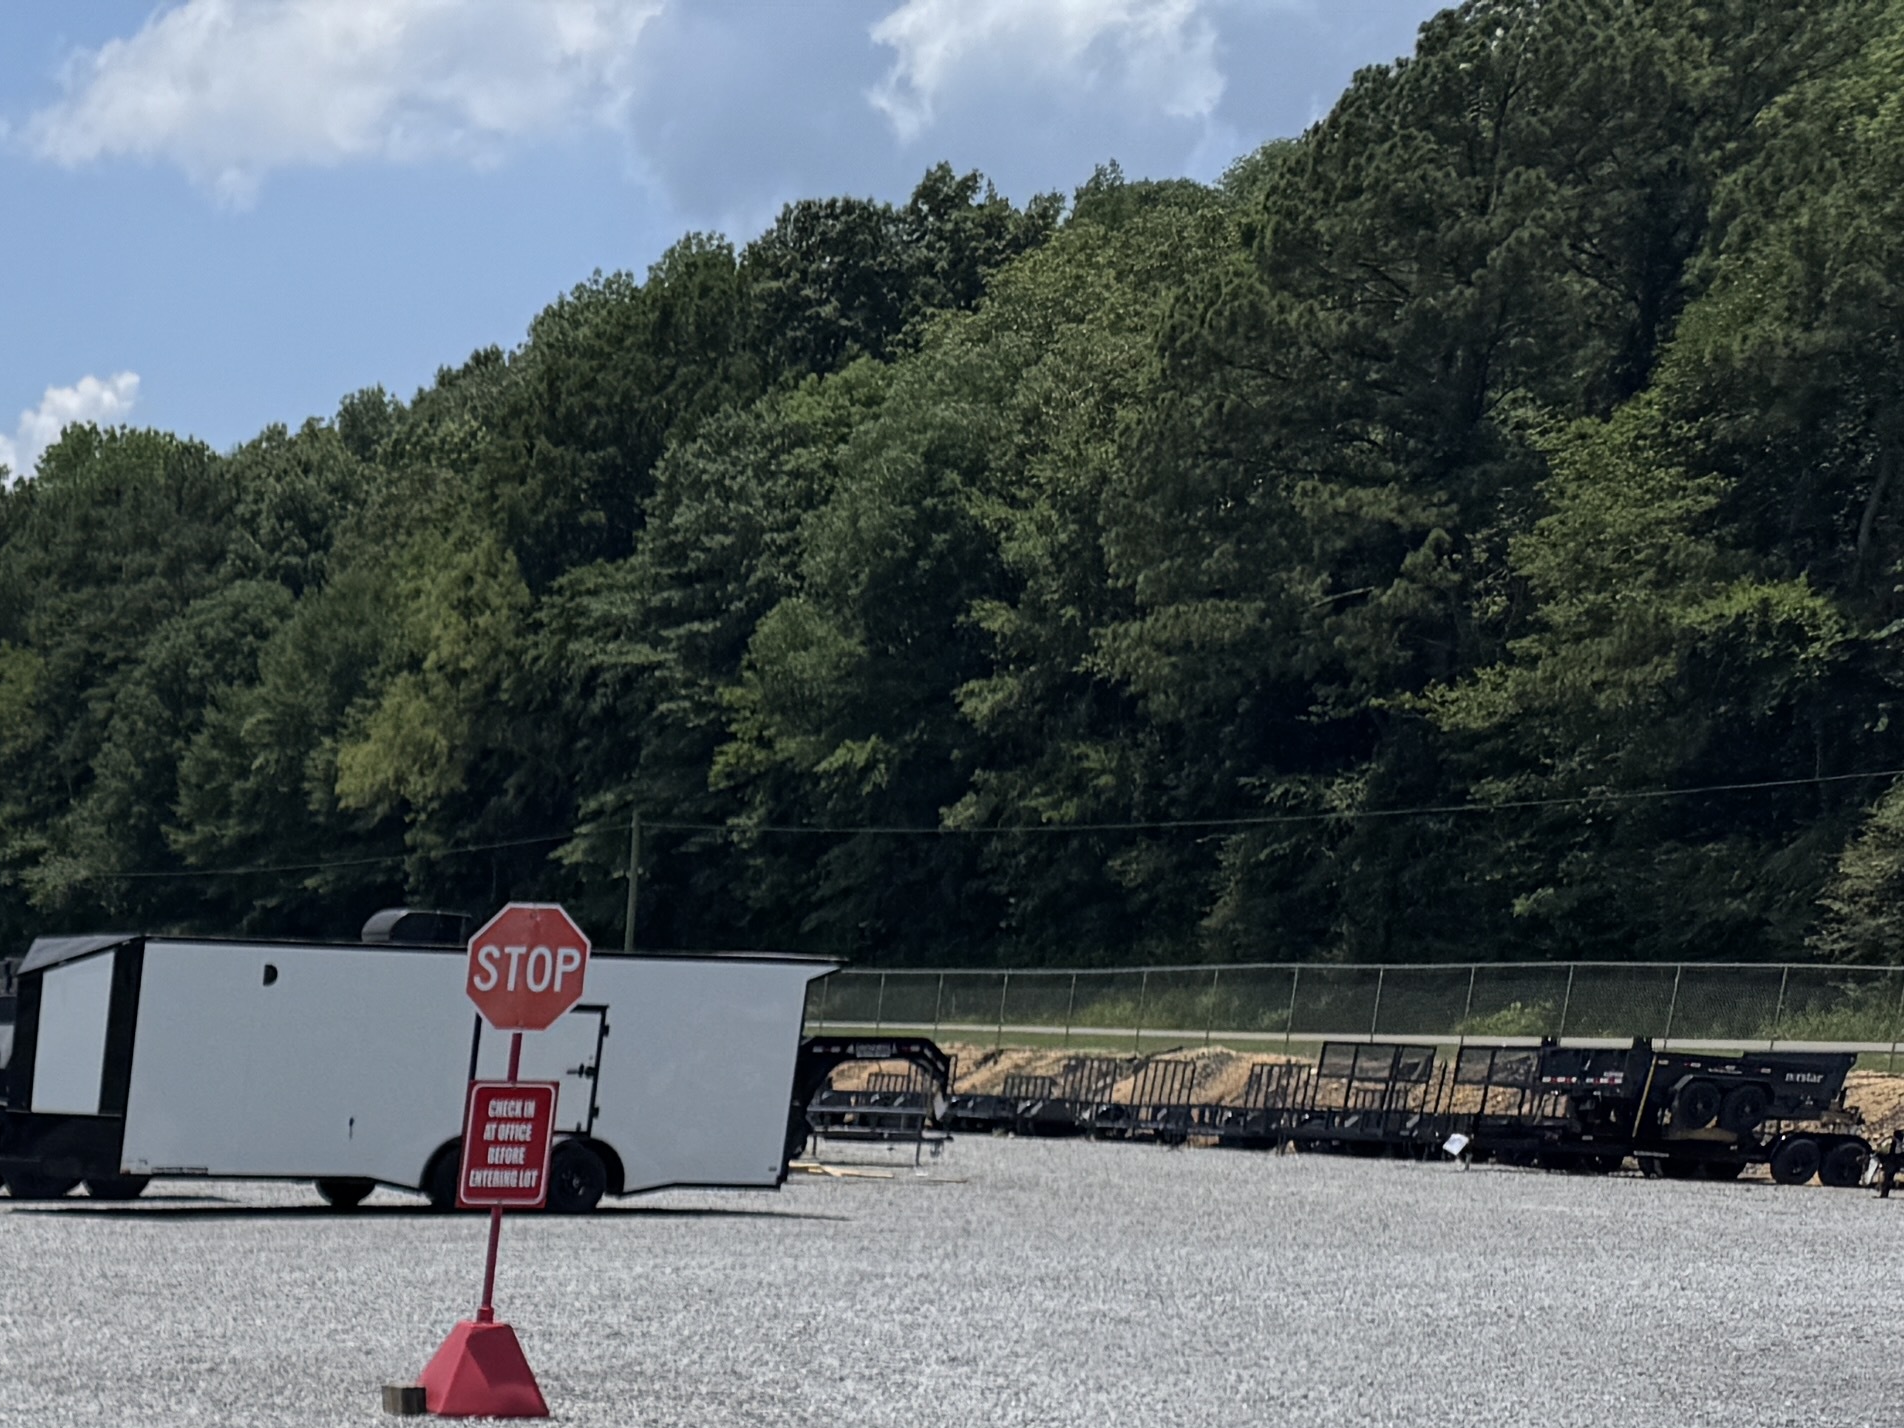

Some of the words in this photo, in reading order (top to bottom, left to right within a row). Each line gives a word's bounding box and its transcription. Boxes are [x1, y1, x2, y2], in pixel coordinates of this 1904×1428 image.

[473, 944, 582, 993] STOP
[488, 1099, 522, 1119] CHECK
[523, 1099, 536, 1119] IN
[483, 1122, 496, 1141] AT
[496, 1122, 532, 1142] OFFICE
[487, 1146, 527, 1165] BEFORE
[469, 1168, 518, 1189] ENTERING
[519, 1169, 539, 1189] LOT
